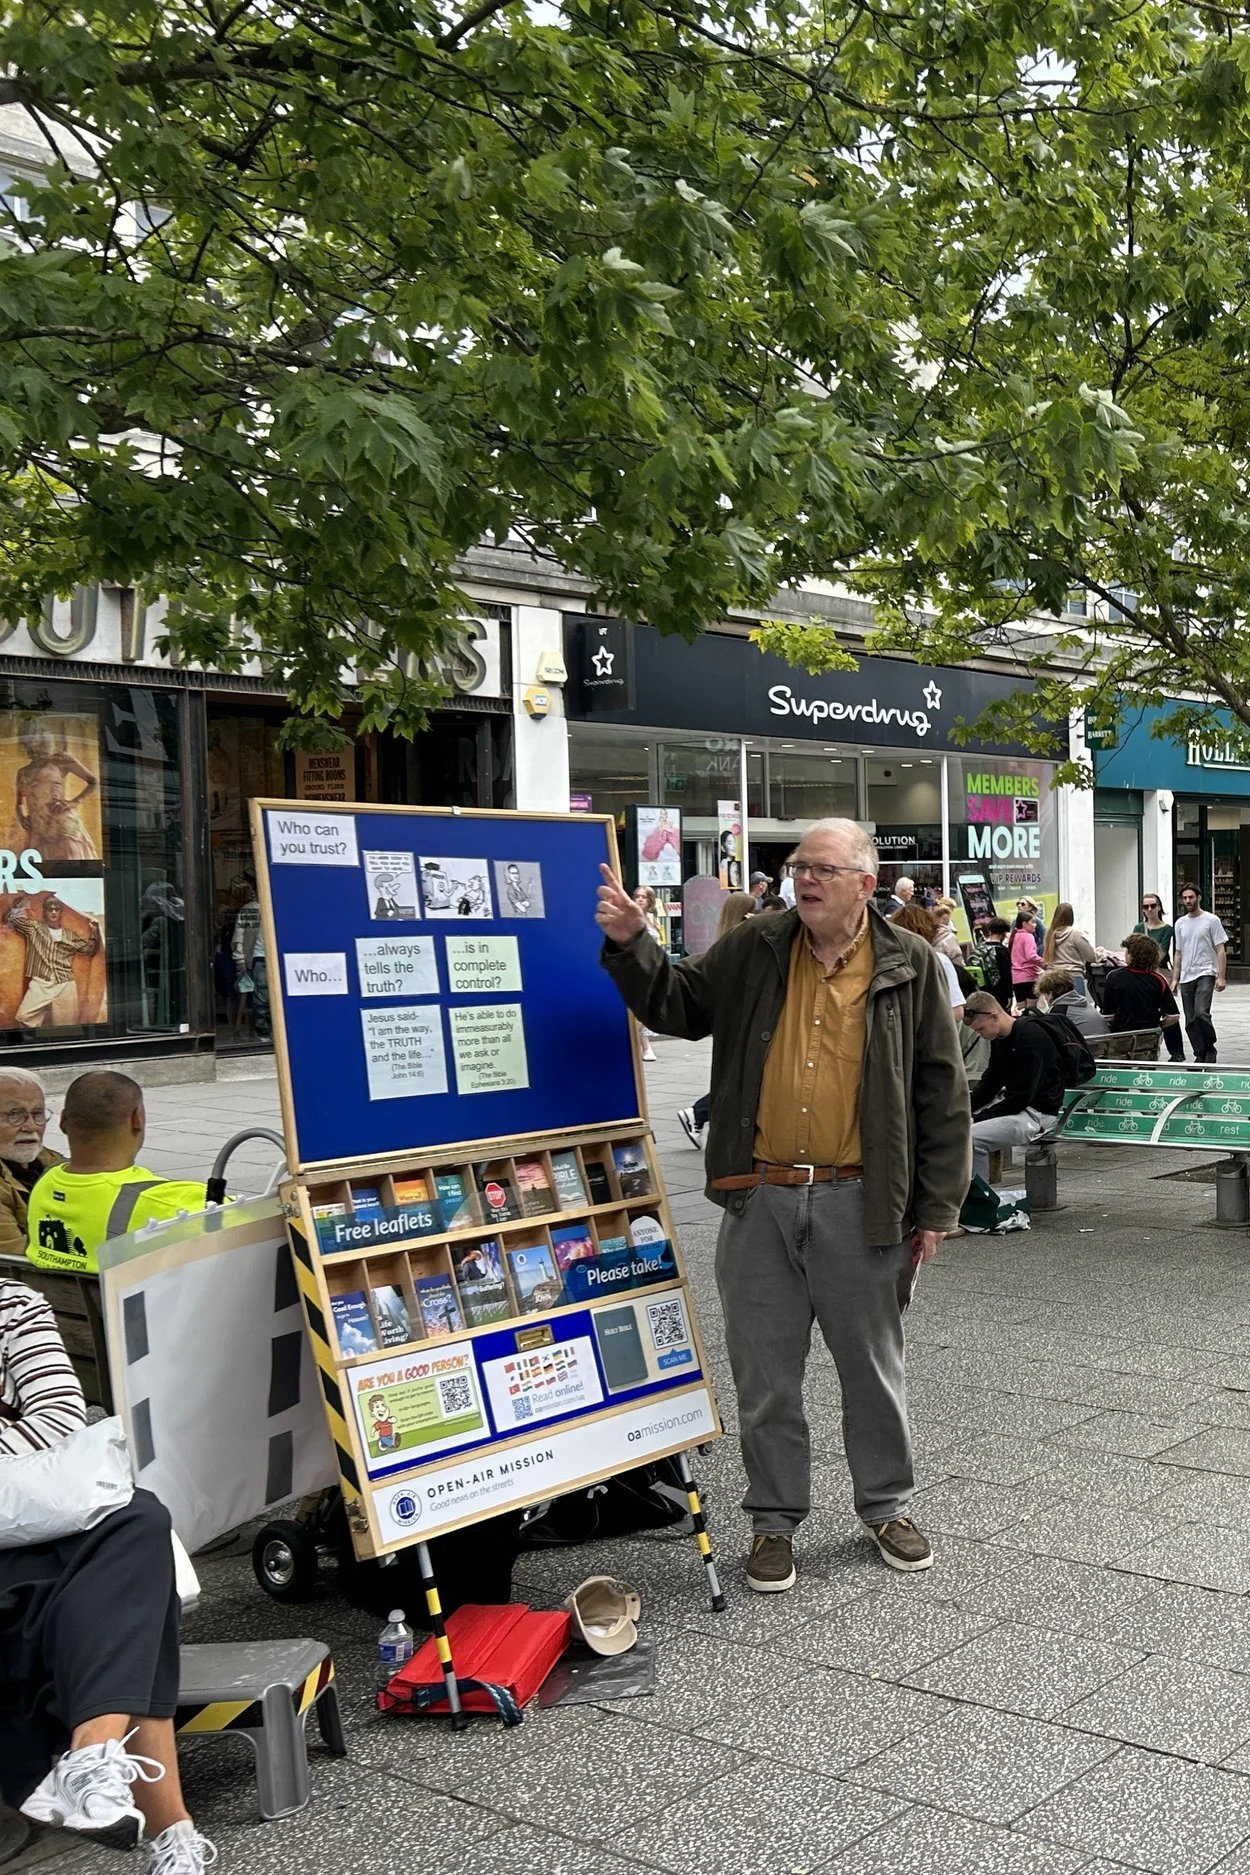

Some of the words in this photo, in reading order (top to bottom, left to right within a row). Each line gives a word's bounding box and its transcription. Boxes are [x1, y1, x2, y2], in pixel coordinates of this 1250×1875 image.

[768, 685, 931, 737] Superdrug
[308, 757, 340, 769] MENSWEAR
[326, 769, 346, 780] ROOMS
[966, 773, 1039, 796] MEMBERS
[967, 796, 1013, 823] SAVE
[278, 820, 311, 835] Who
[315, 825, 339, 836] can
[872, 836, 916, 846] OLUTION
[968, 825, 1041, 859] MORE
[280, 842, 306, 856] you
[310, 842, 347, 855] trust?
[990, 872, 1004, 884] VIP
[1006, 873, 1041, 884] REWARDS
[363, 942, 421, 958] ...always
[453, 942, 476, 954] ...is
[478, 942, 489, 954] in
[364, 962, 390, 974] tells
[394, 962, 414, 974] the
[454, 960, 506, 976] complete
[295, 968, 342, 983] Who...
[367, 979, 403, 993] truth?
[456, 976, 502, 989] control?
[367, 1013, 395, 1024] Jesus
[398, 1012, 420, 1022] said-
[454, 1011, 475, 1022] He's
[477, 1010, 494, 1020] able
[496, 1010, 504, 1018] to
[506, 1009, 517, 1018] do
[378, 1028, 393, 1036] am
[395, 1025, 410, 1034] the
[456, 1022, 514, 1034] immeasurably
[370, 1039, 385, 1050] the
[388, 1037, 422, 1048] TRUTH
[458, 1037, 479, 1047] more
[482, 1035, 500, 1044] than
[502, 1034, 512, 1043] all
[372, 1052, 389, 1062] and
[392, 1051, 406, 1062] the
[458, 1050, 472, 1058] we
[474, 1048, 489, 1058] ask
[491, 1048, 500, 1056] or
[407, 1062, 423, 1070] Bible
[460, 1062, 496, 1073] imagine.
[392, 1071, 407, 1079] John
[493, 1070, 507, 1078] Bible
[1100, 1074, 1118, 1084] ride
[1169, 1076, 1187, 1087] ride
[470, 1080, 499, 1090] Ephesians
[1115, 1097, 1133, 1107] ride
[1186, 1100, 1204, 1110] ride
[1087, 1118, 1105, 1128] ride
[1220, 1124, 1240, 1135] rest
[487, 1190, 504, 1201] STOP
[335, 1224, 372, 1243] Free
[374, 1212, 432, 1236] leaflets
[632, 1226, 658, 1238] ANYONE
[640, 1235, 654, 1244] FOR
[37, 1250, 88, 1270] SOUTHAMPTON
[587, 1266, 629, 1286] Please
[630, 1254, 662, 1276] take!
[422, 1294, 452, 1308] Cross?
[535, 1290, 552, 1303] JOHN
[348, 1302, 366, 1312] Enough
[604, 1328, 618, 1336] HOLY
[619, 1324, 632, 1334] BIBLE
[662, 1356, 679, 1366] SCAN
[680, 1354, 688, 1362] ME
[358, 1377, 374, 1392] ARE
[376, 1372, 394, 1386] YOU
[396, 1370, 404, 1382] A
[405, 1364, 430, 1380] GOOD
[432, 1354, 470, 1373] PERSON?
[532, 1390, 554, 1404] Read
[555, 1381, 584, 1397] online!
[627, 1408, 704, 1442] oamission.com
[427, 1469, 495, 1499] OPEN-AIR
[500, 1449, 554, 1476] MISSION
[430, 1496, 450, 1512] Good
[450, 1490, 469, 1506] news
[470, 1489, 480, 1499] on
[480, 1484, 490, 1497] the
[492, 1477, 514, 1494] streets
